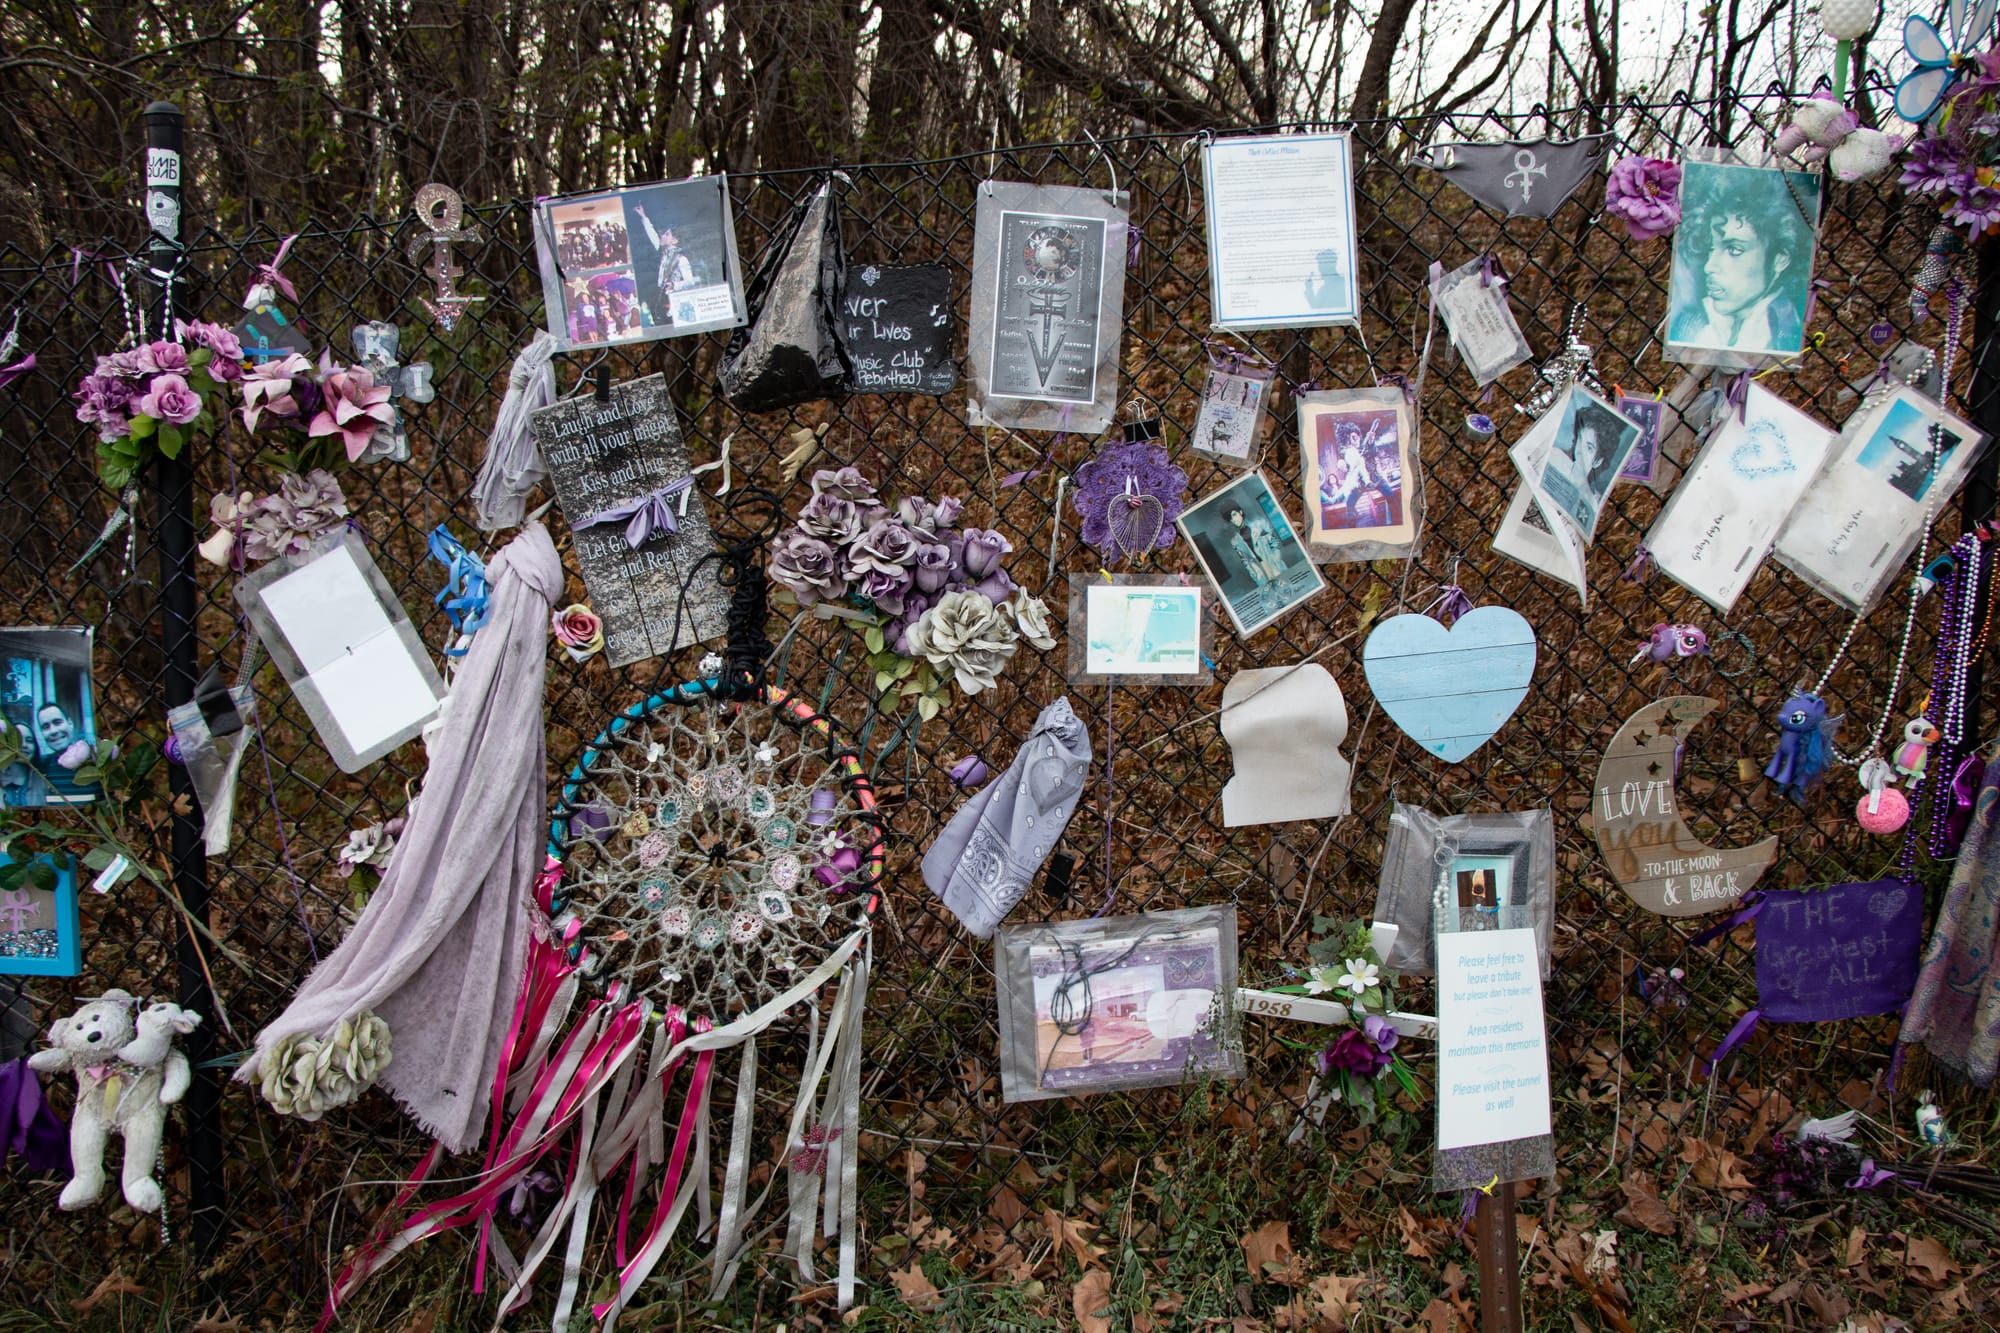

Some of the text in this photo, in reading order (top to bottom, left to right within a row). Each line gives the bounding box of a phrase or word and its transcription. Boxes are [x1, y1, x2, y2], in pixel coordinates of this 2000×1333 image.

[871, 319, 913, 341] Lives
[551, 397, 657, 439] Laugh and Love
[551, 417, 674, 466] with all your might
[579, 474, 609, 495] Kiss
[610, 463, 636, 485] and
[585, 514, 699, 560] Let Go Saess
[621, 543, 690, 579] and Regret
[1601, 779, 1672, 822] LOVE
[1599, 821, 1704, 882] you
[1664, 871, 1742, 906] & BACK
[1768, 892, 1845, 930] THE
[1459, 953, 1525, 968] Please feel free to
[1827, 957, 1881, 987] ALL
[1467, 974, 1489, 985] leave
[1498, 970, 1521, 982] tribute
[1246, 998, 1293, 1018] 1958
[1453, 992, 1466, 1001] but
[1466, 989, 1489, 1001] please
[1467, 1020, 1524, 1036] Area residents
[1448, 1036, 1541, 1058] maintain this memorial
[1452, 1074, 1542, 1096] Please visit the tunnel
[1485, 1095, 1515, 1112] as well
